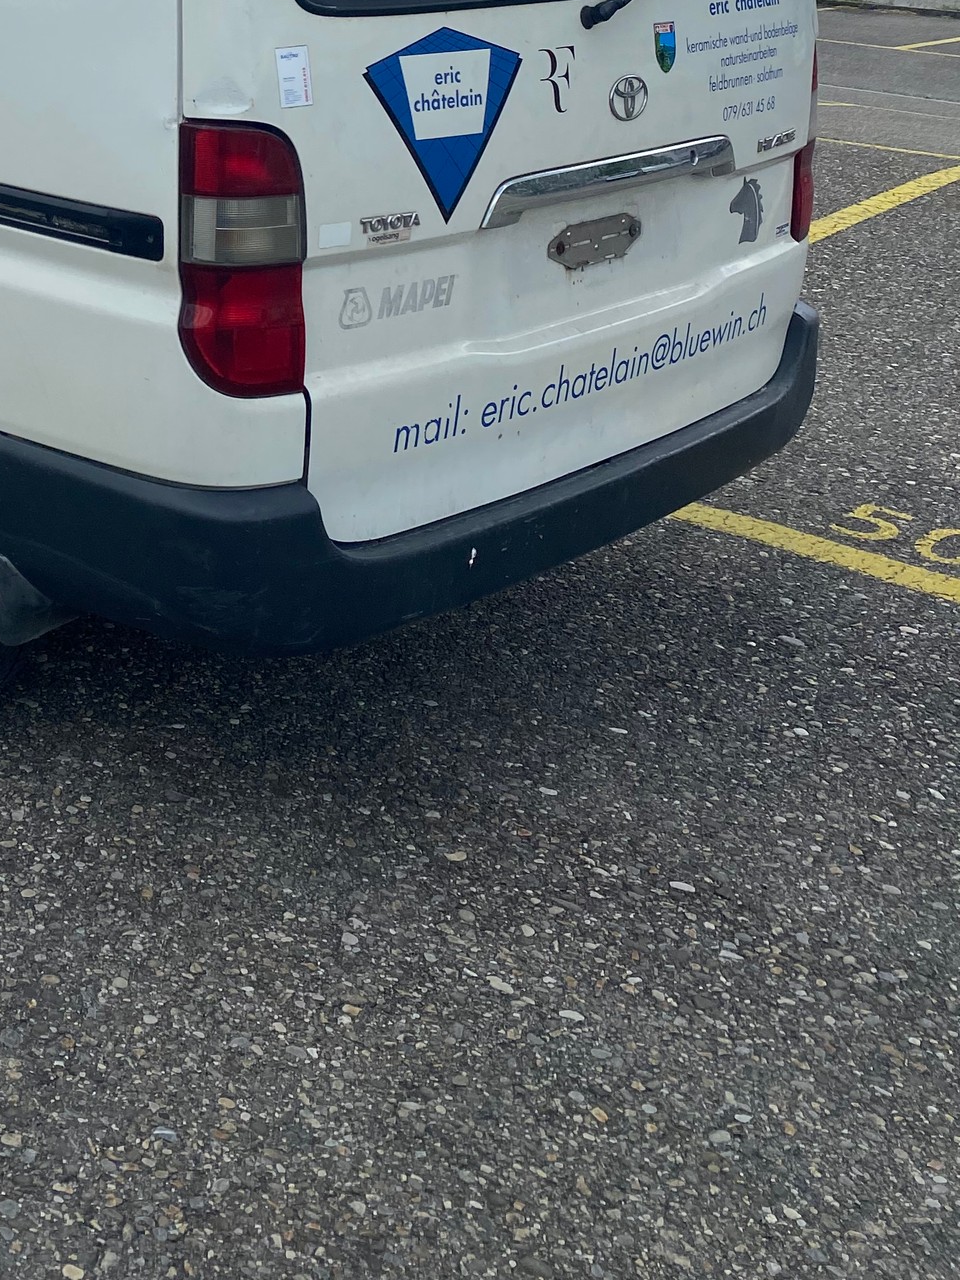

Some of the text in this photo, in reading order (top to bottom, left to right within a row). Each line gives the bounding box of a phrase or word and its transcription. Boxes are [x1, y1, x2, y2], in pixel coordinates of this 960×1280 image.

[686, 32, 728, 54] keramische
[763, 19, 798, 39] bodenbeläge
[720, 44, 777, 67] natursteinarbeiten
[434, 66, 461, 86] eric
[708, 74, 753, 92] feldbrunnen
[413, 88, 482, 113] châtelain
[722, 95, 776, 121] 079/631 45 68
[360, 211, 420, 234] TOYOTA
[376, 274, 455, 320] MAPEI
[392, 292, 767, 453] mail: eric.chatelain@bluewin.ch
